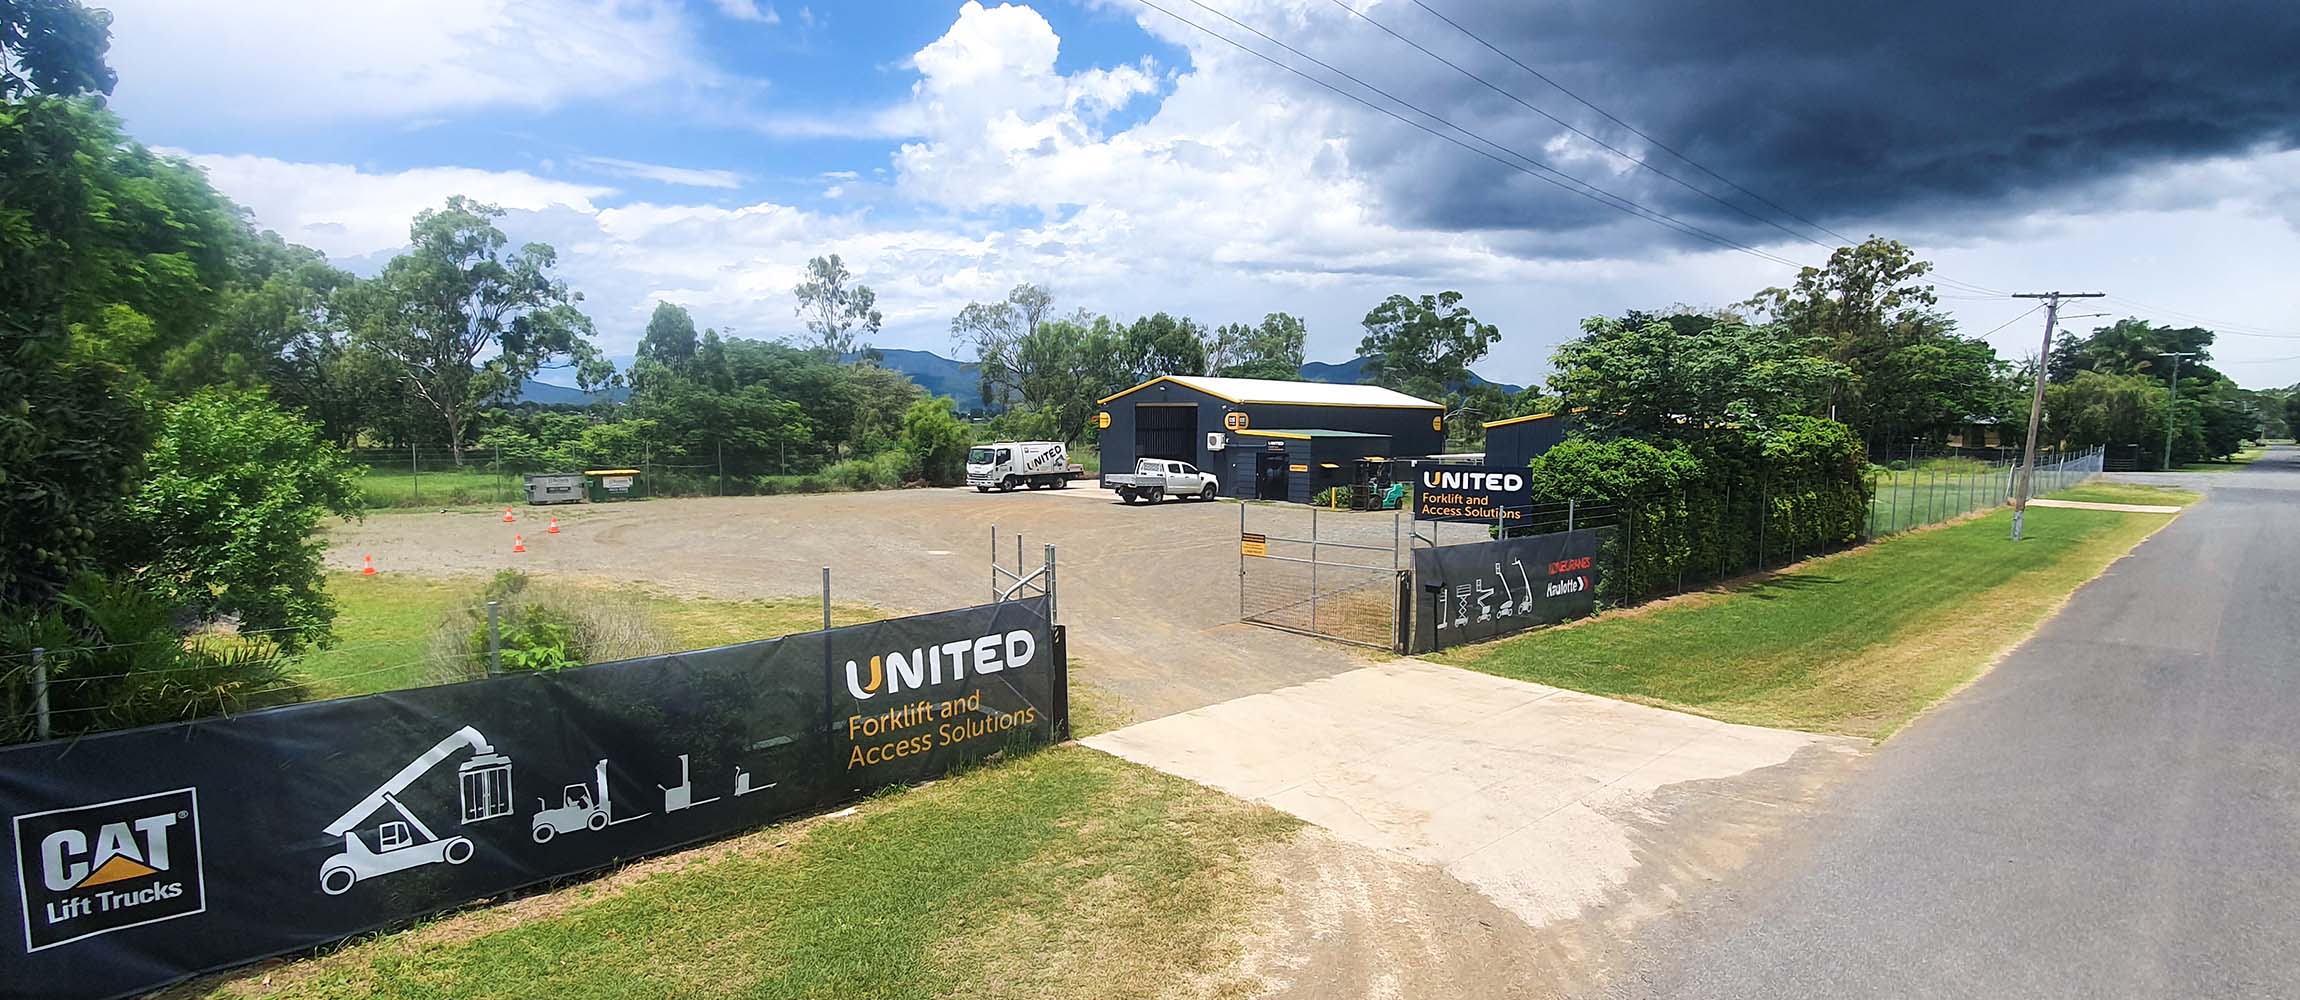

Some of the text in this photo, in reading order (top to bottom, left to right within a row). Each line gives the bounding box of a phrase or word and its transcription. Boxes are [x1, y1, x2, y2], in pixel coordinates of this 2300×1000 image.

[1027, 445, 1062, 471] UNITED
[1422, 492, 1489, 506] Forklift and
[1423, 471, 1524, 492] UNITED
[1422, 504, 1521, 519] Access Solutions
[845, 629, 1036, 700] UNITED
[848, 688, 981, 741] Forklift and
[847, 705, 1036, 770] Access Solutions
[41, 812, 177, 891] CAT
[46, 881, 183, 924] Lift Trucks
